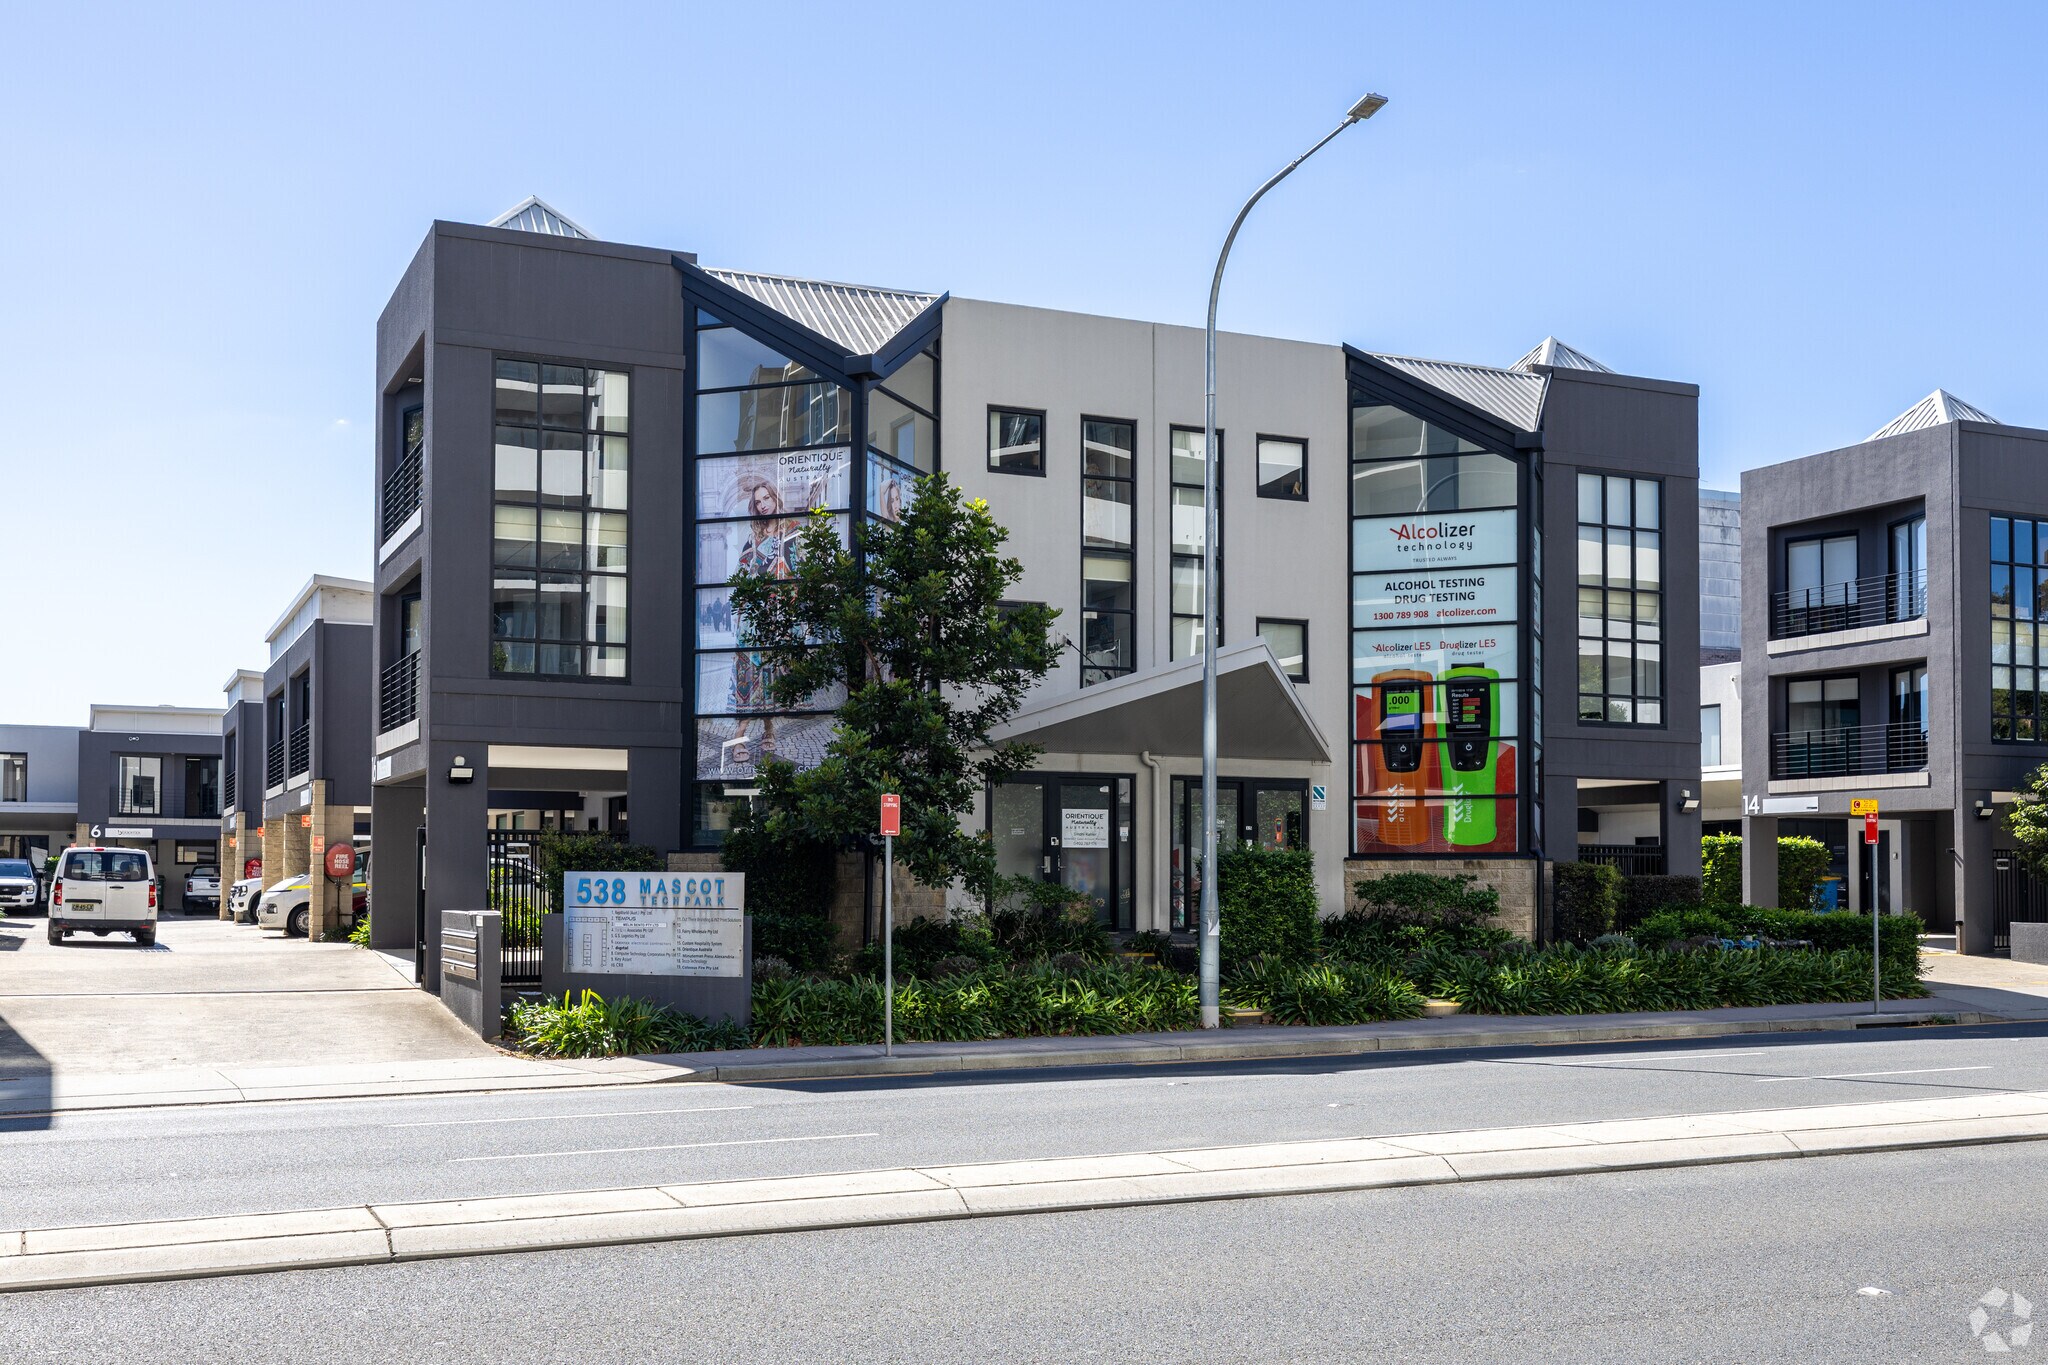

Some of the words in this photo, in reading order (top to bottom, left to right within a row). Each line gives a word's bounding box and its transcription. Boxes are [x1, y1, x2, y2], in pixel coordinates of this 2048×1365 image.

[779, 452, 843, 465] ORIENTIQUE
[789, 463, 832, 474] Naturally
[1390, 522, 1476, 540] Alcolizer
[1397, 541, 1473, 552] technology
[1385, 580, 1436, 591] ALCOHOL
[1439, 578, 1485, 588] TESTING
[1394, 594, 1426, 604] DRUG
[1430, 592, 1476, 602] TESTING
[1374, 612, 1394, 620] 1300
[1396, 612, 1412, 620] 789
[1414, 610, 1429, 618] 908
[1436, 608, 1496, 618] alcolizer.com
[1372, 643, 1414, 652] Alcolizer
[1414, 642, 1432, 650] LE5
[1440, 640, 1478, 652] Druglizer
[1479, 639, 1496, 648] LE5
[1389, 696, 1410, 705] .000
[1743, 795, 1760, 814] 14
[91, 825, 101, 838] 6
[577, 878, 626, 905] 538
[640, 878, 725, 895] MASCOT
[641, 896, 725, 906] TECHPARK
